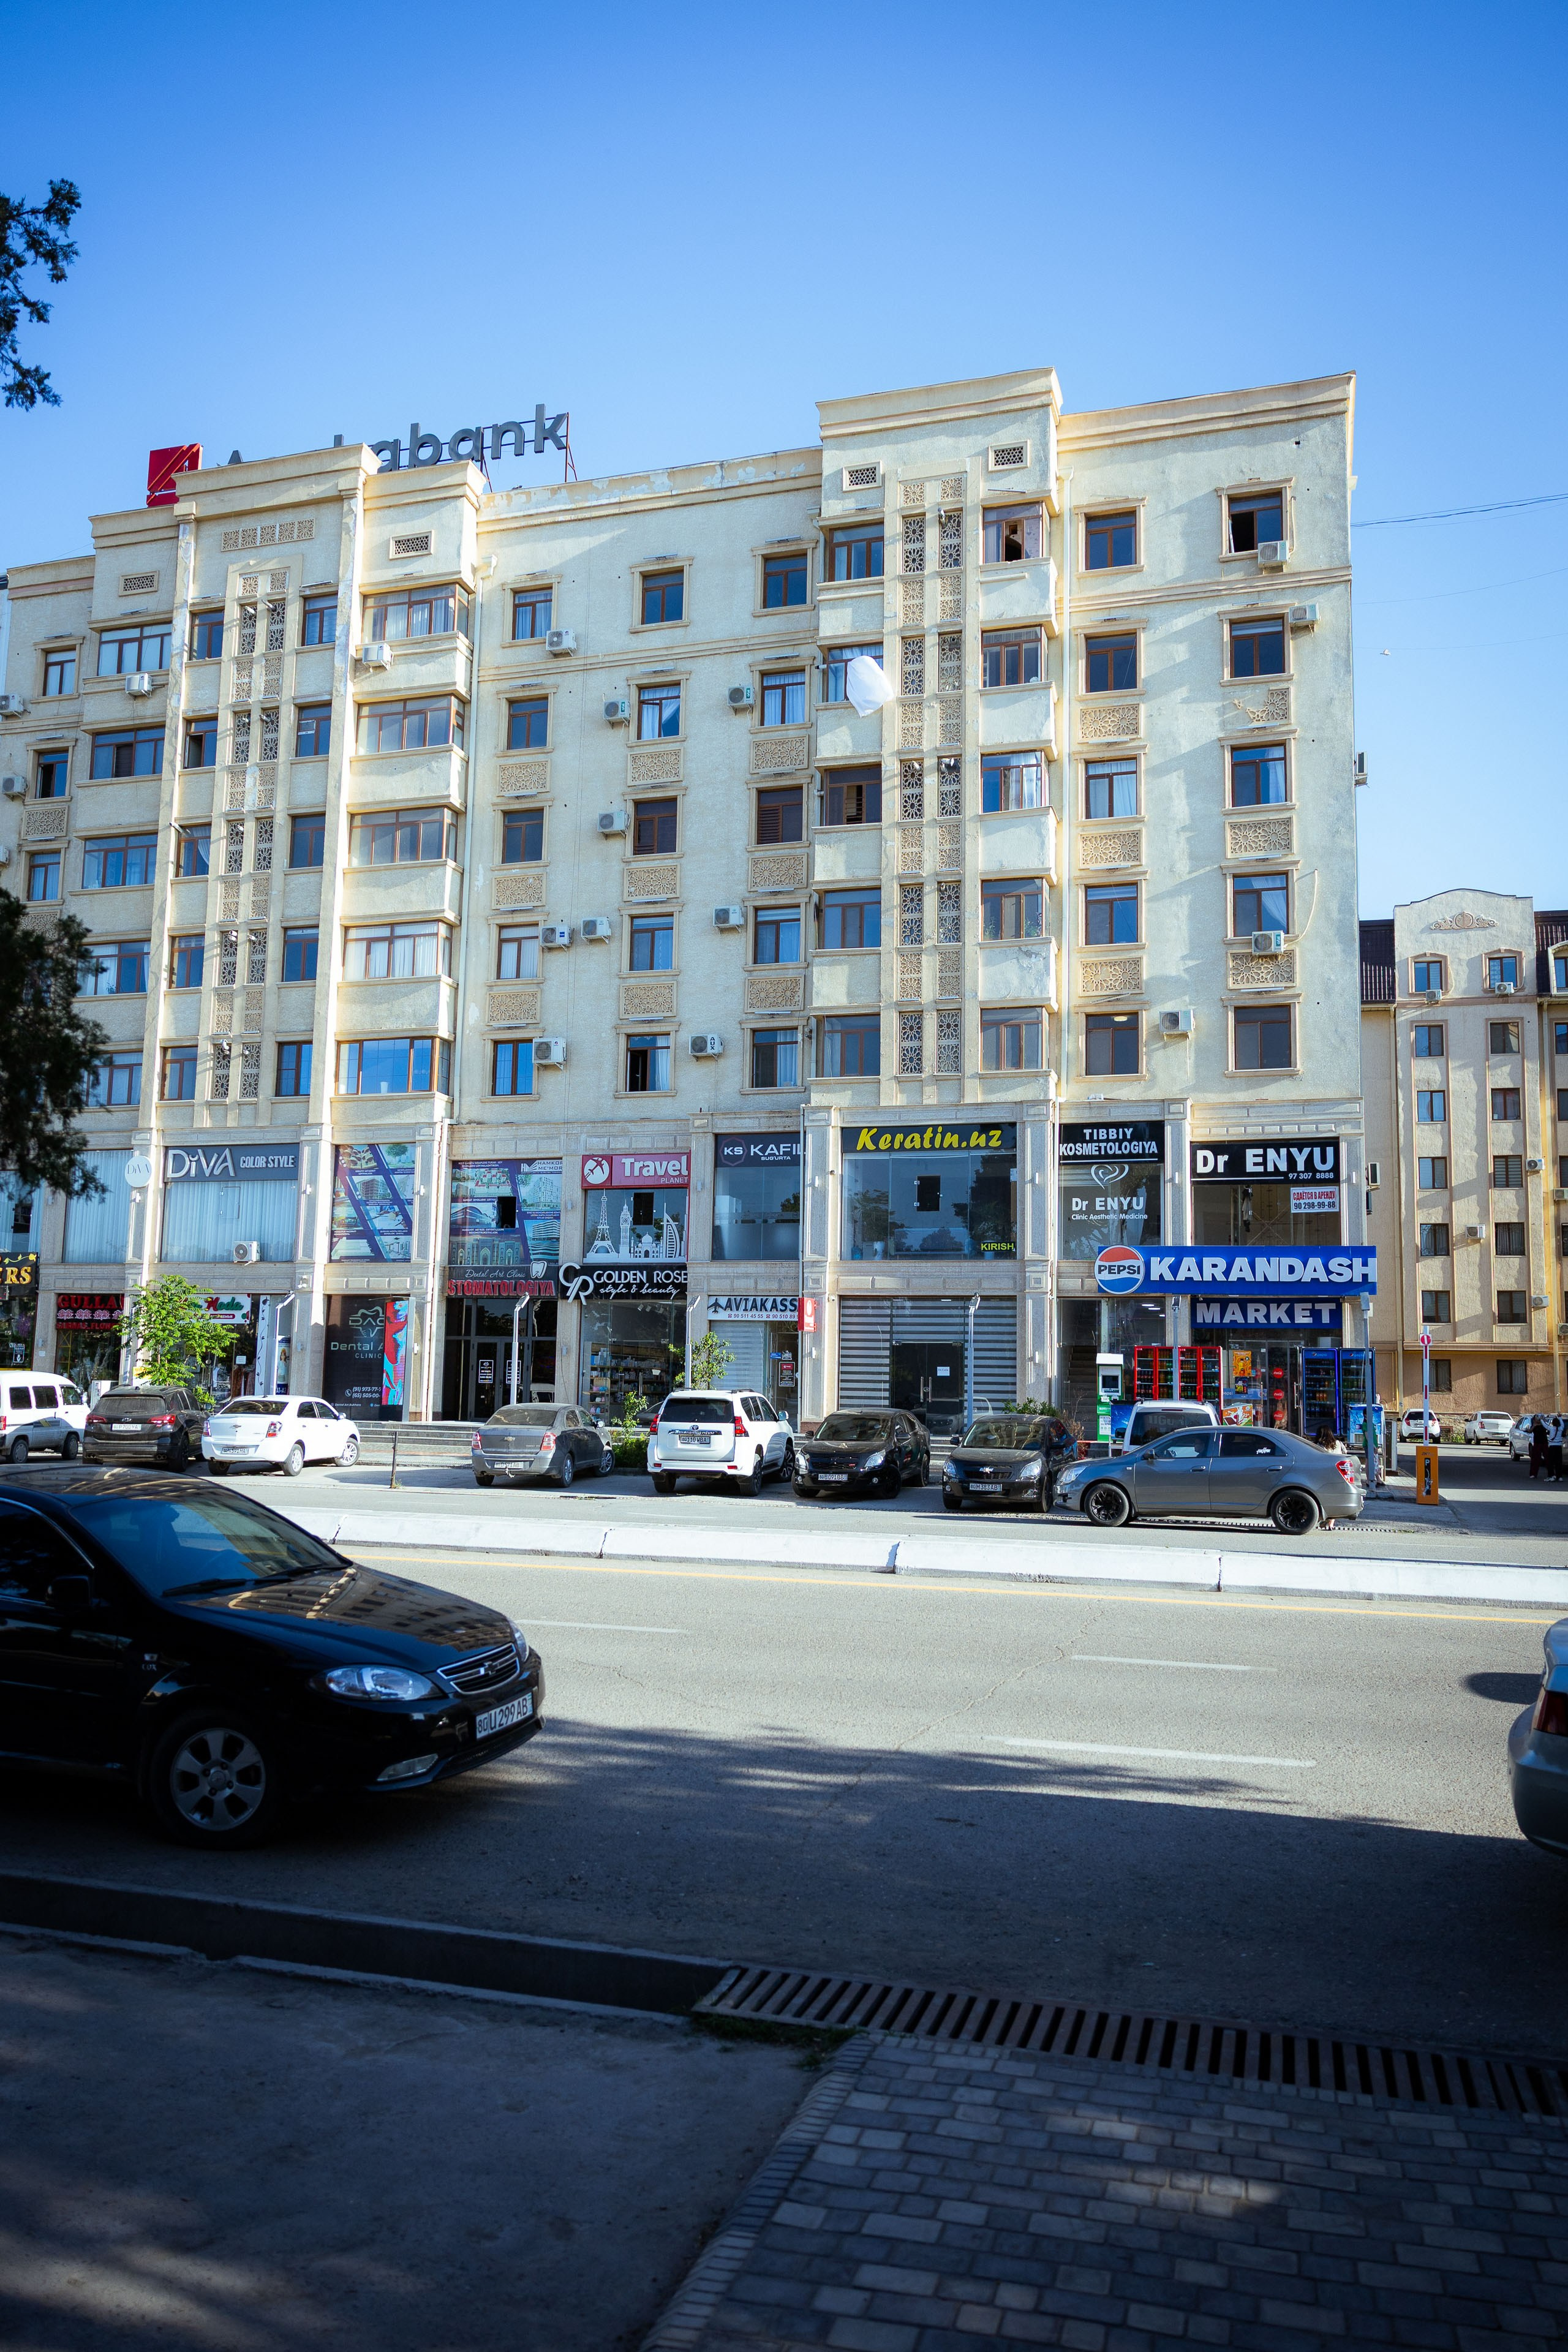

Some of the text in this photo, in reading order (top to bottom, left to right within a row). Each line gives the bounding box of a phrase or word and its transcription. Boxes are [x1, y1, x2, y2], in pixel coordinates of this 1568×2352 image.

[856, 1126, 1002, 1151] Keratin.uz
[1084, 1128, 1133, 1140] TIBBIY
[724, 1147, 743, 1155] KS
[1059, 1141, 1158, 1156] KOSMETOLOGIYA
[239, 1155, 295, 1168] COLOR STYLE
[621, 1155, 688, 1177] Travel
[1196, 1147, 1334, 1173] Dr ENYU
[1293, 1191, 1313, 1201] СДАЁТСЯ
[1317, 1190, 1335, 1200] АРЕНДУ
[1072, 1197, 1144, 1211] Dr ENYU
[465, 1268, 526, 1278] Dental Art Clinic
[593, 1270, 688, 1283] GOLDEN ROSE
[1098, 1264, 1141, 1275] PEPSI
[1150, 1257, 1378, 1282] KARANDASH
[447, 1279, 556, 1297] STOMATOLOGIYA
[599, 1284, 628, 1300] style
[639, 1284, 680, 1300] beauty
[58, 1294, 124, 1309] GULLA
[724, 1297, 799, 1312] AVIAKASS
[1196, 1303, 1336, 1324] MARKET
[331, 1342, 373, 1351] Dental
[478, 1717, 488, 1734] 80
